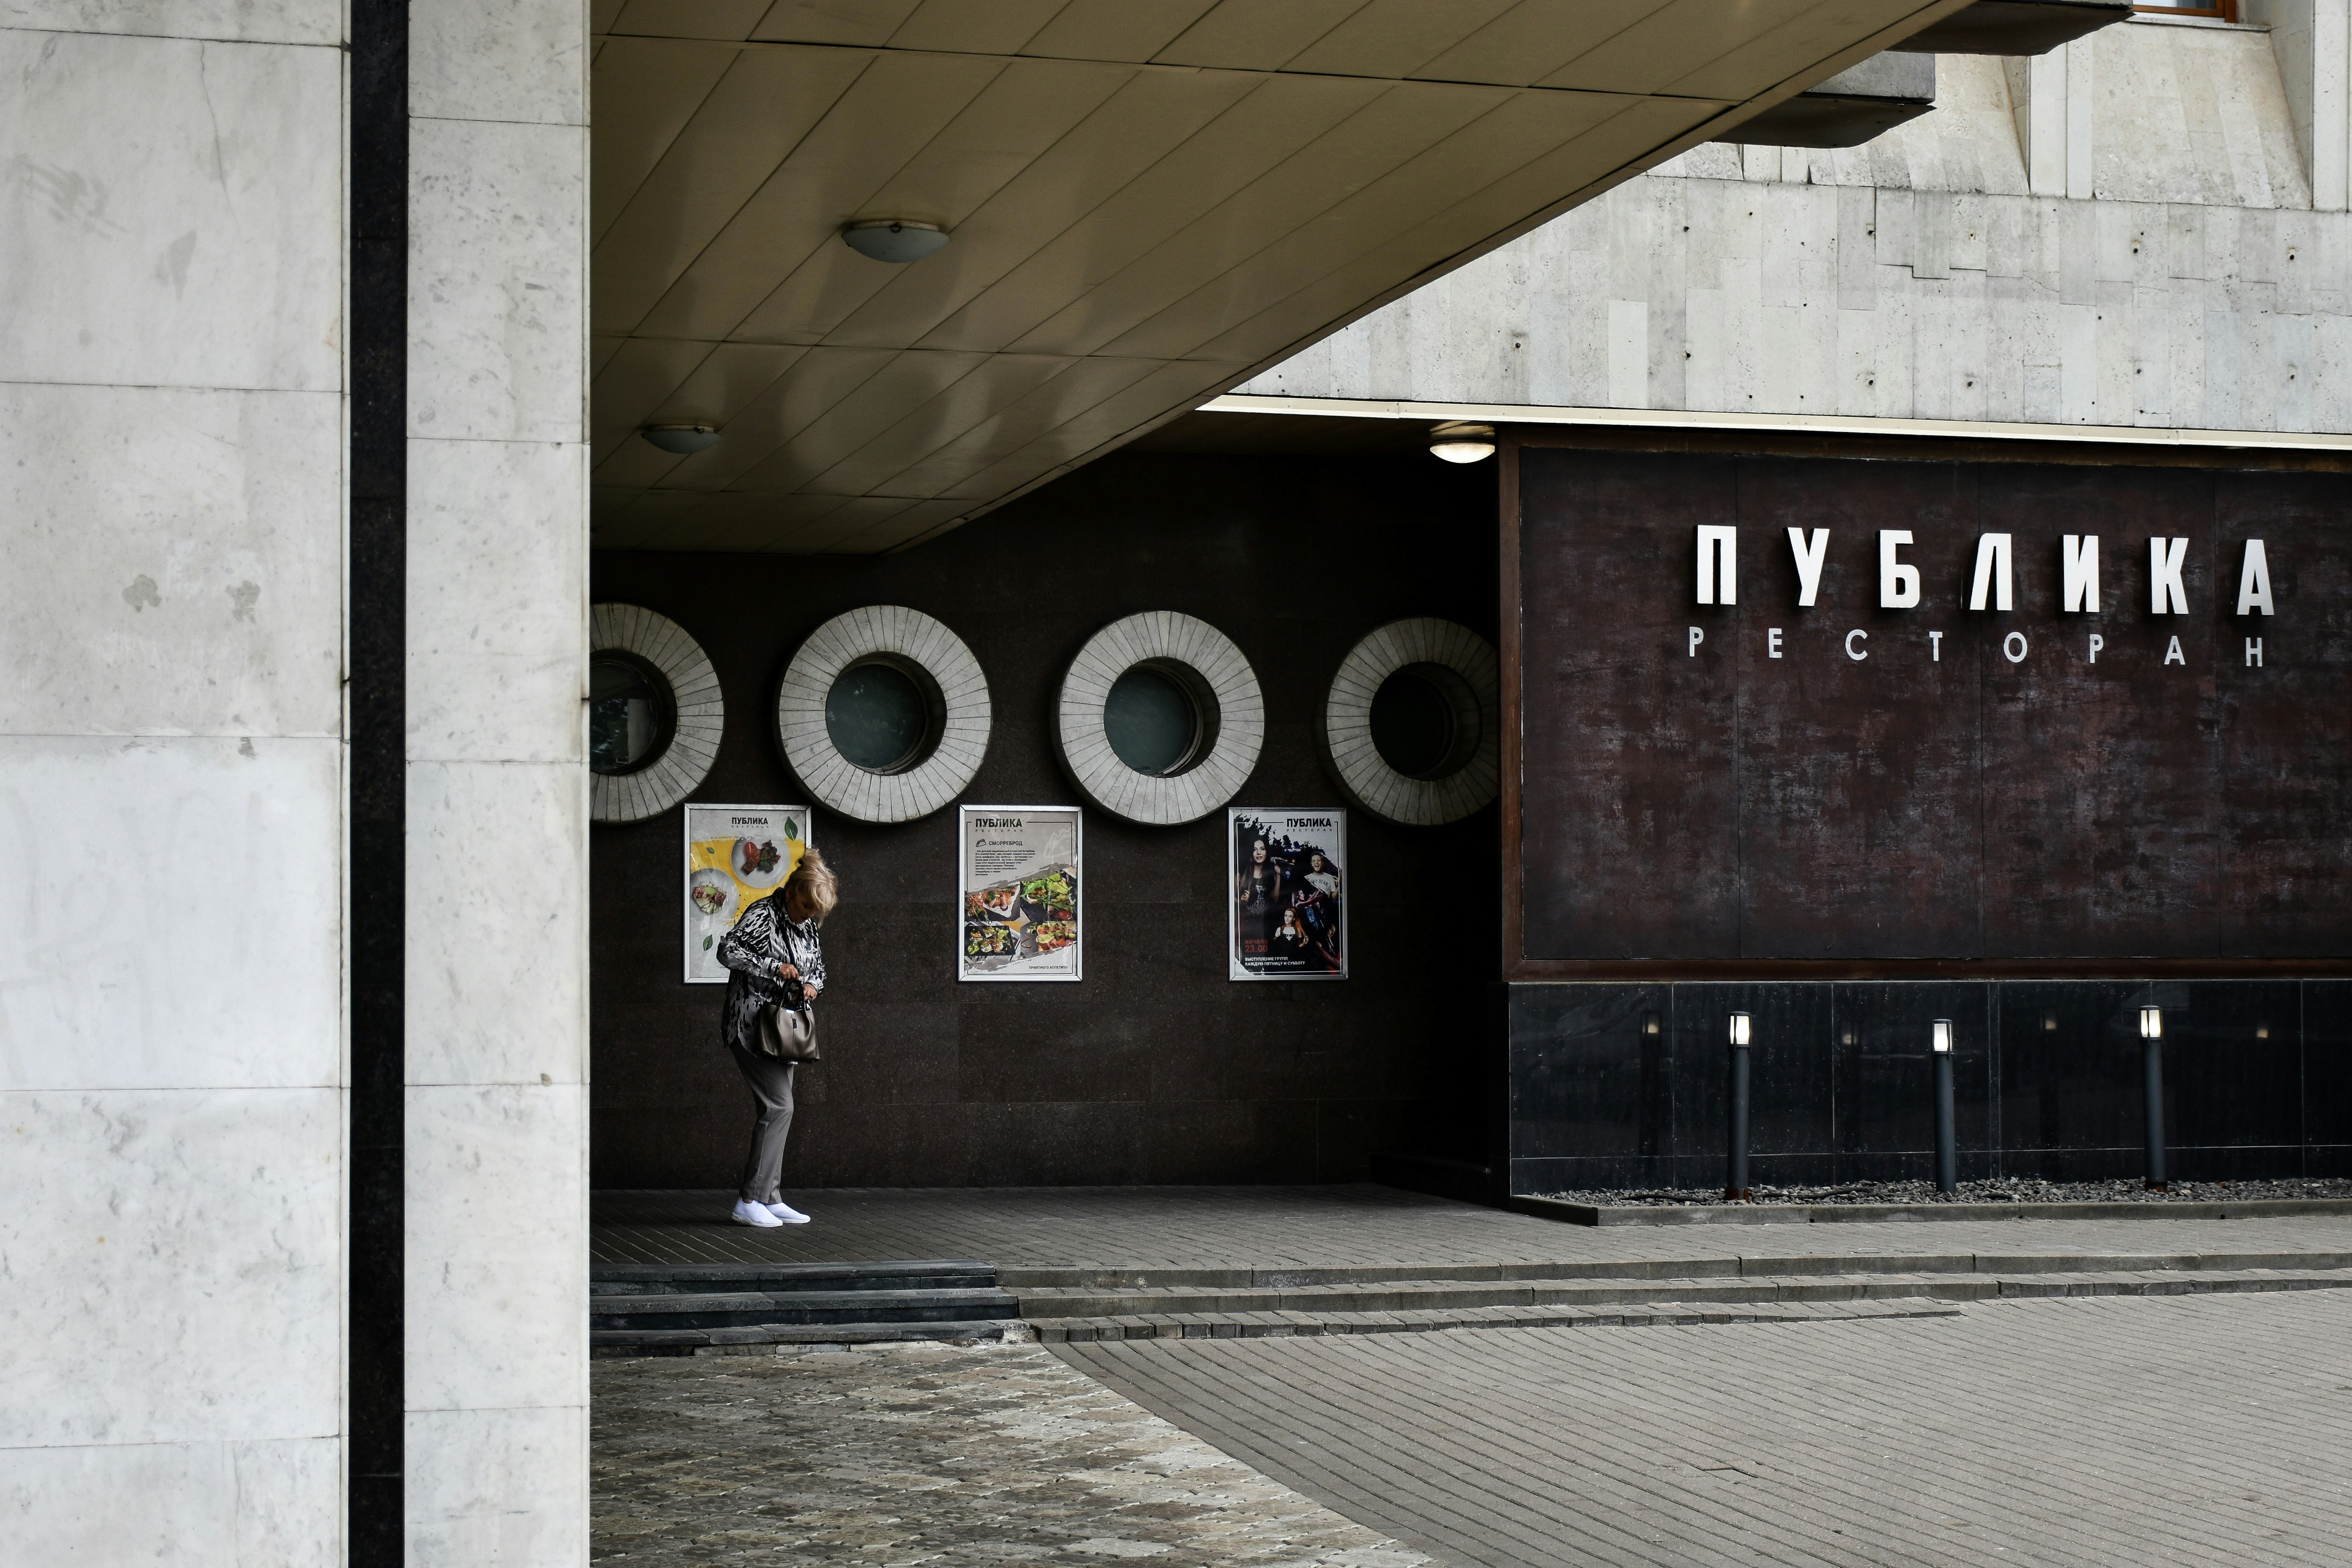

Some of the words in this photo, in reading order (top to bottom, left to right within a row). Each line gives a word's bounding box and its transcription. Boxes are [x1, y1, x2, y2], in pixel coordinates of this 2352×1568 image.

[1695, 524, 2275, 616] ПУБЛИКА
[1688, 626, 2263, 668] РЕСТОРАН
[976, 819, 1023, 828] ПУБЛИКА
[1287, 818, 1332, 827] ПУБЛИКА
